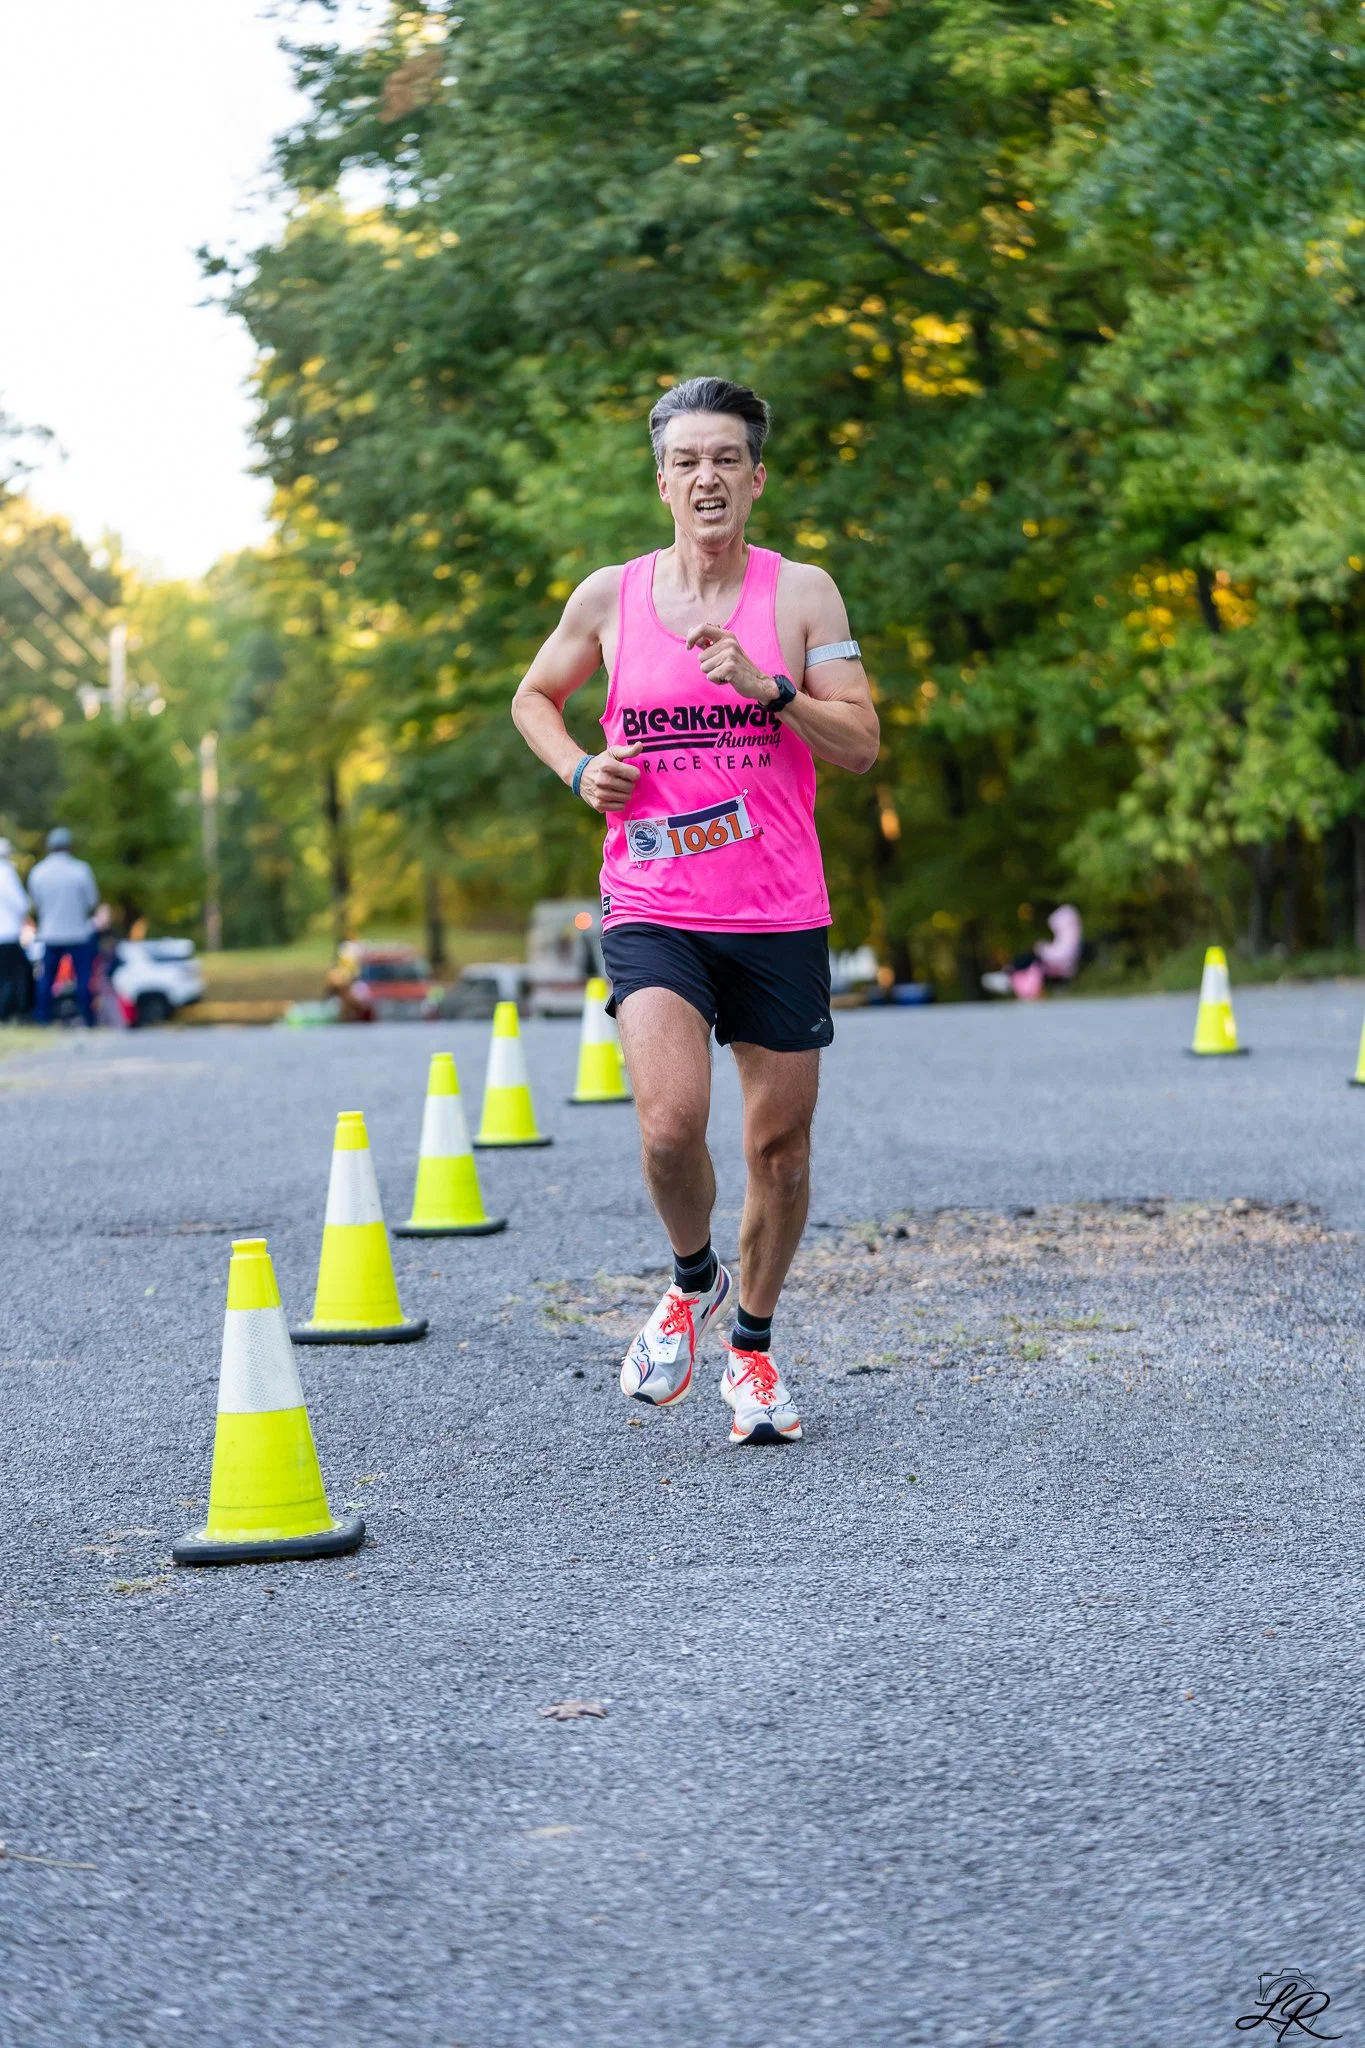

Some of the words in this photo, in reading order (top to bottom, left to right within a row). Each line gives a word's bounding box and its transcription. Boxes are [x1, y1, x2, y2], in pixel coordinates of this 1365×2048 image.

[716, 728, 782, 749] Running
[643, 755, 702, 774] RACE
[713, 752, 772, 770] TEAM
[667, 812, 743, 856] 1061
